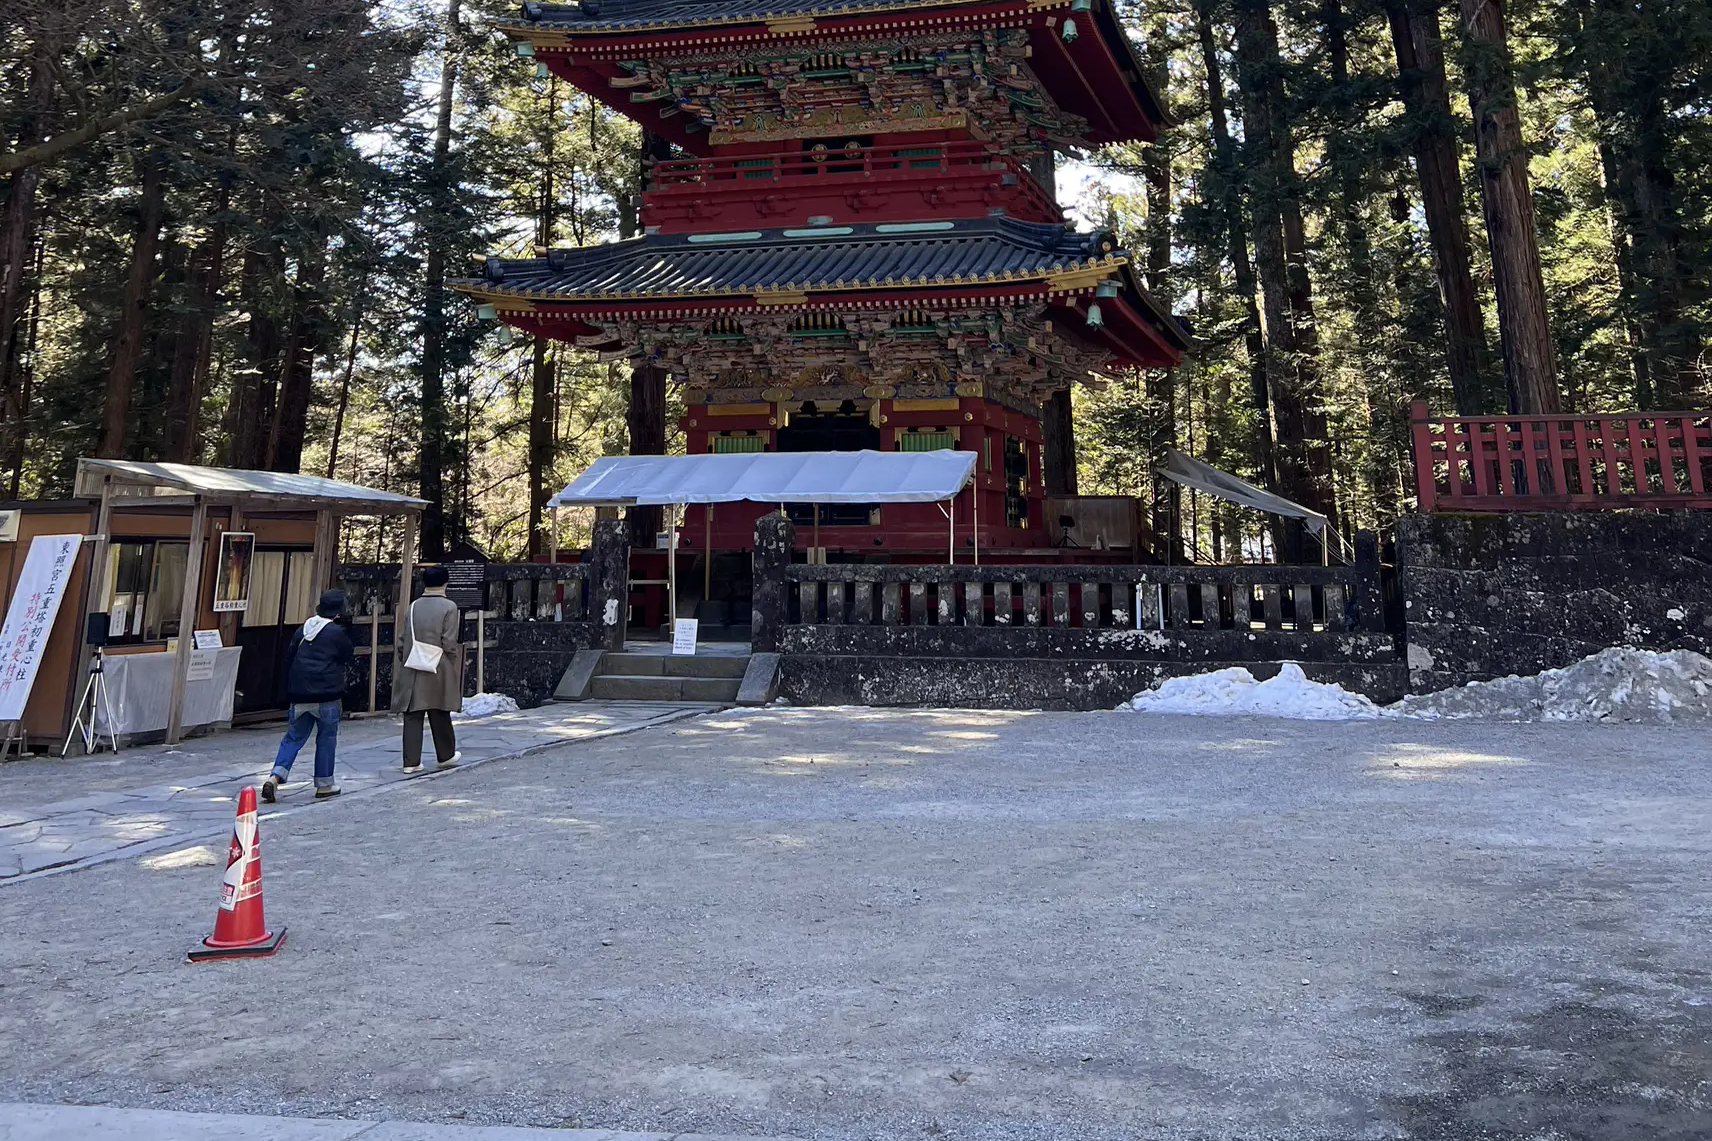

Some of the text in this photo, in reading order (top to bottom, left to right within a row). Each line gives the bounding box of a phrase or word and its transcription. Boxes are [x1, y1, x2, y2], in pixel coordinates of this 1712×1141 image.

[0, 593, 42, 691] 特別公開受付所
[15, 541, 70, 681] 東照宮五重塔初重心柱
